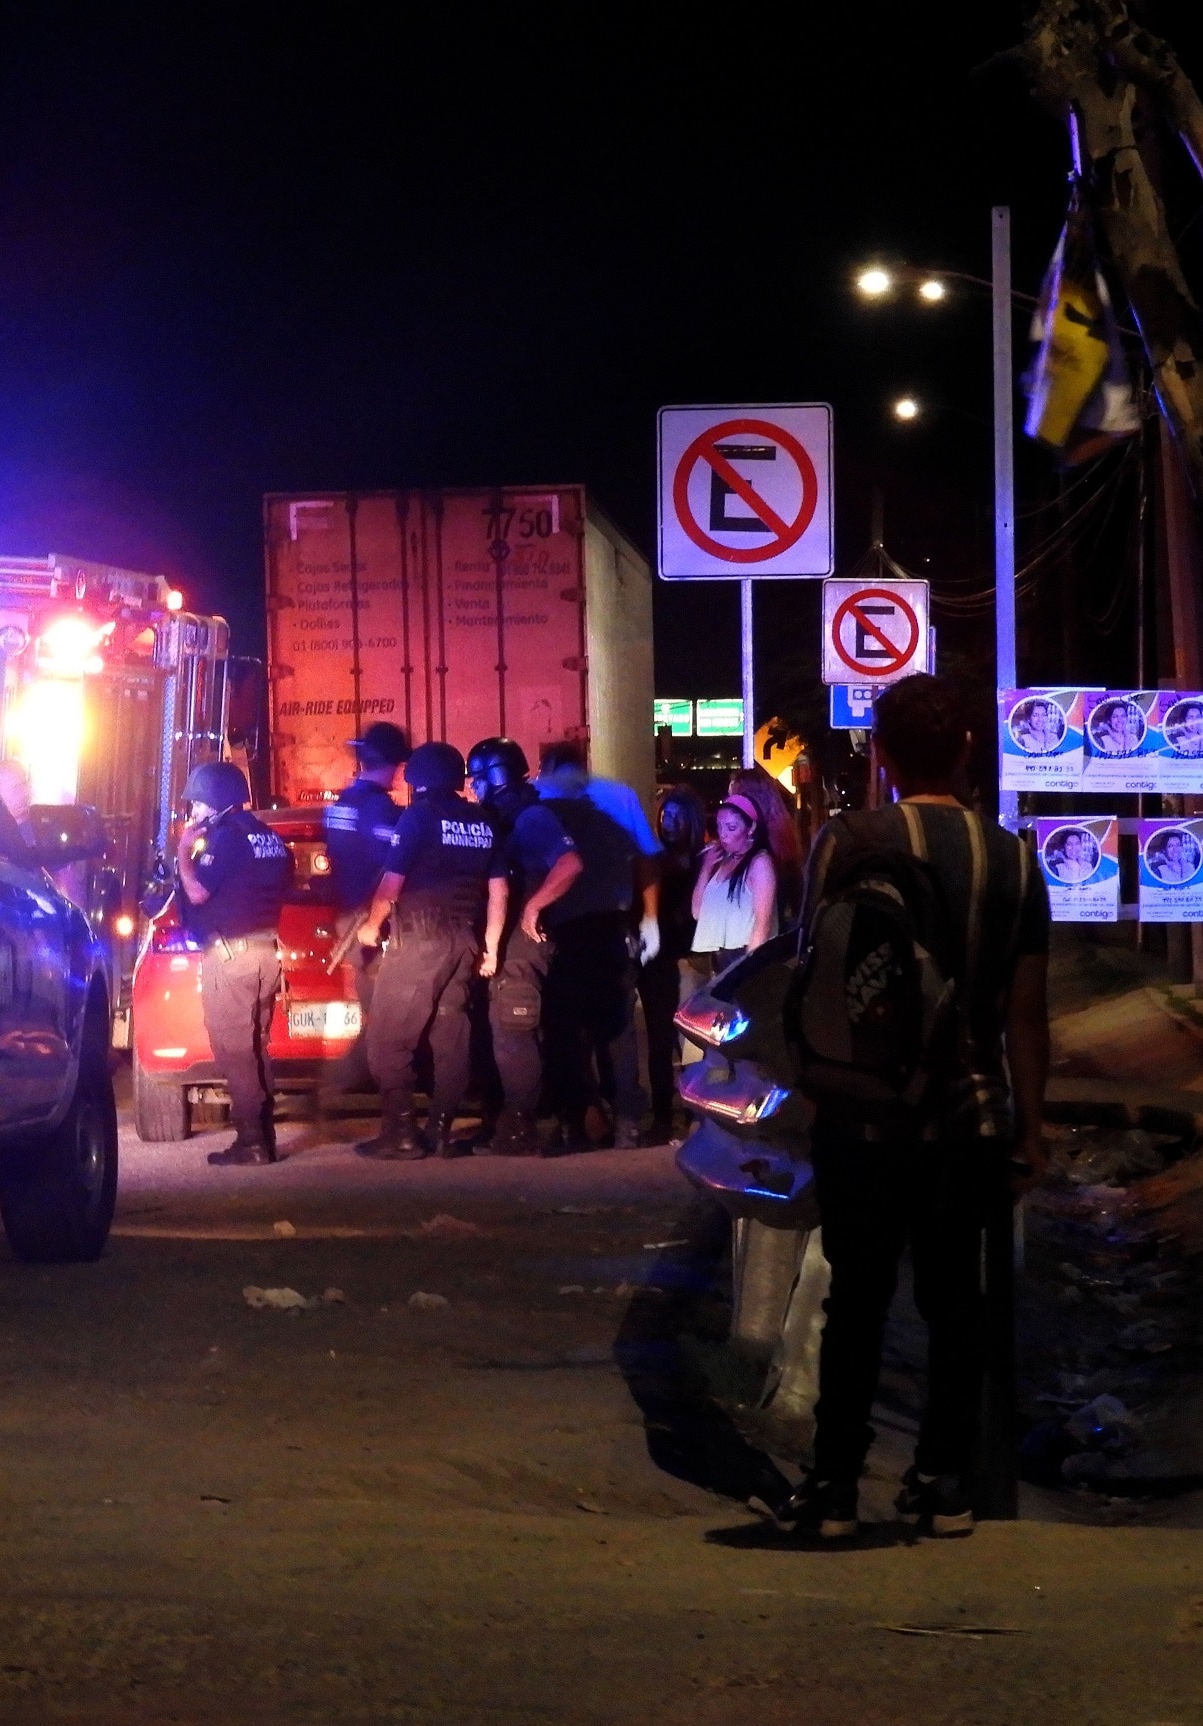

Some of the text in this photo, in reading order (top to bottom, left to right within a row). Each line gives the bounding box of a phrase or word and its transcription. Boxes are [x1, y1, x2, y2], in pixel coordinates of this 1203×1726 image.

[482, 506, 552, 539] 7750
[457, 614, 548, 626] Mantemiento
[280, 700, 334, 716] AIR-RIDE
